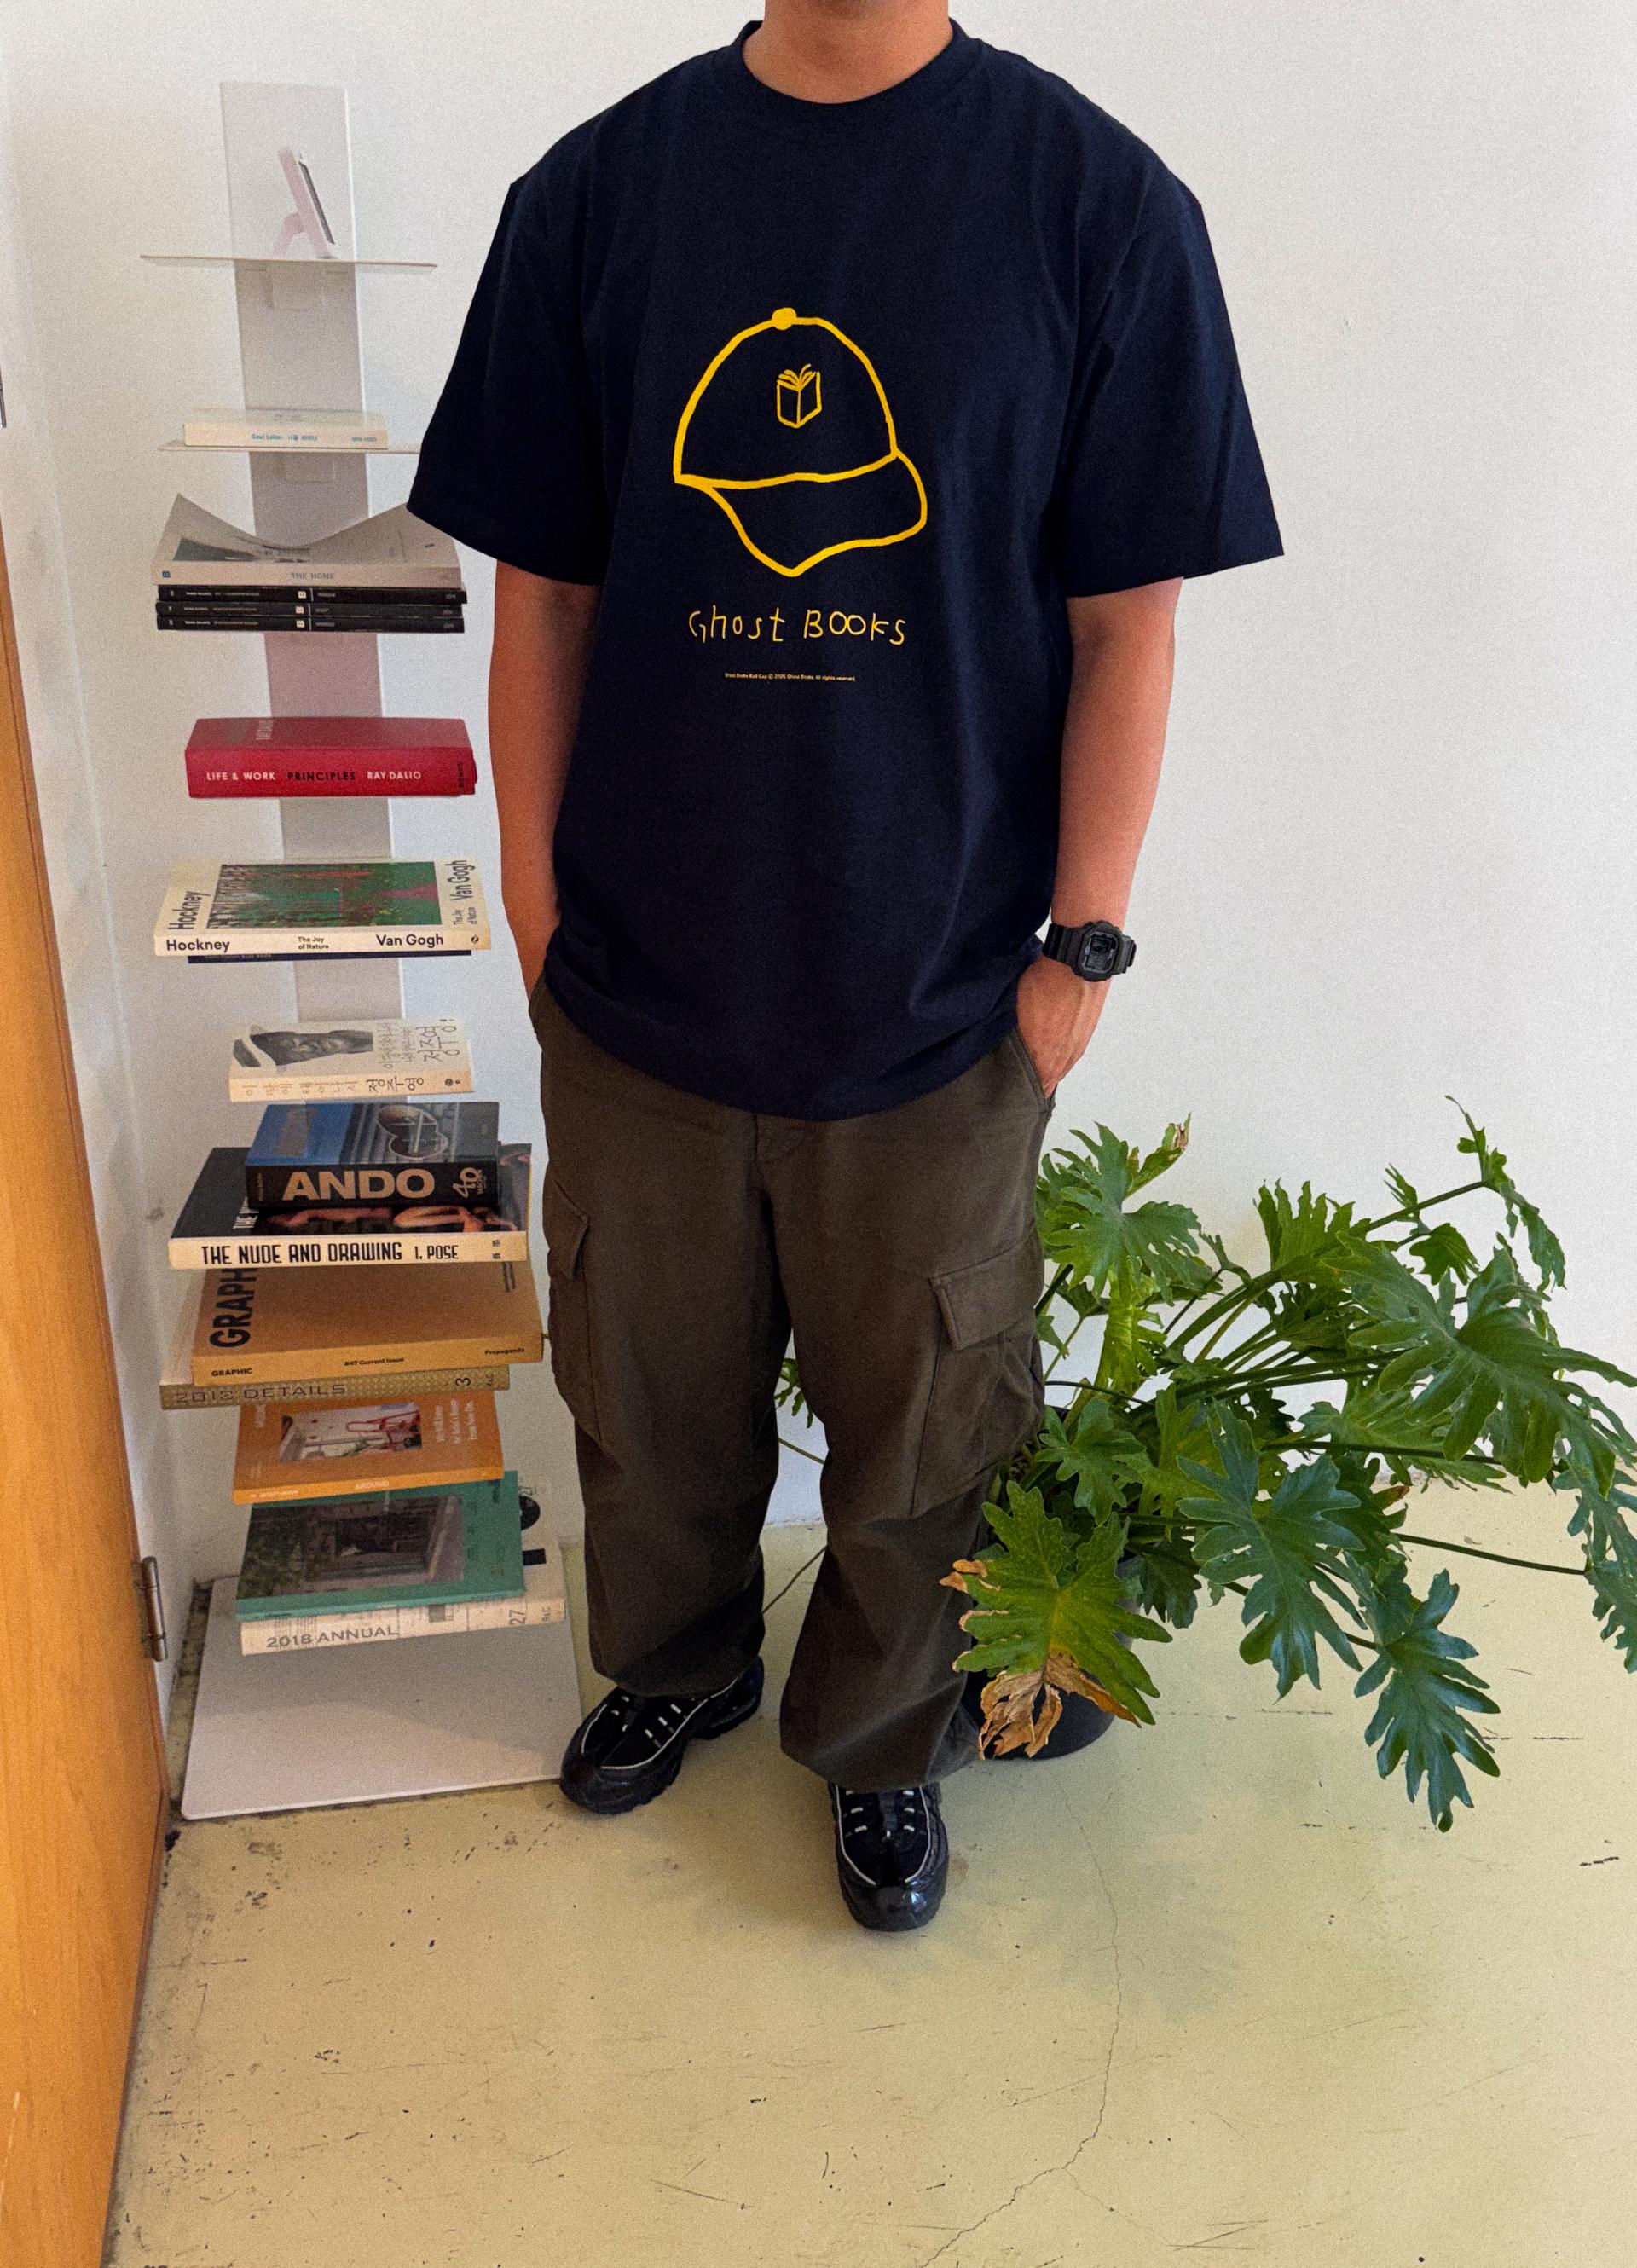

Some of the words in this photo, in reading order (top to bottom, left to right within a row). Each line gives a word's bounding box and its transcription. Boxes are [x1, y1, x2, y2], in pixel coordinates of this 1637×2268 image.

[689, 605, 785, 643] Ghost
[206, 771, 228, 781] LIFE
[232, 771, 239, 781] &
[243, 771, 276, 781] WORK
[286, 771, 356, 781] PRINCIPLES
[367, 771, 386, 780] RAY
[389, 771, 421, 780] DALIO
[443, 860, 476, 883] Gogh
[449, 884, 473, 901] Van
[167, 890, 211, 931] Hockney
[165, 938, 230, 953] Hockney
[312, 936, 324, 945] Joy
[377, 934, 402, 946] Van
[406, 933, 443, 948] Gogh
[367, 1076, 425, 1093] 정주영
[281, 1168, 435, 1201] ANDO
[201, 1245, 230, 1265] THE
[238, 1243, 281, 1264] NUDE
[289, 1243, 321, 1262] AND
[327, 1241, 402, 1262] DRAWING
[426, 1244, 459, 1260] POSE
[211, 1368, 253, 1377] GRAPHIC
[455, 1377, 471, 1386] 3
[244, 1383, 346, 1400] DETAILS
[508, 1609, 525, 1626] 27
[317, 1625, 400, 1644] ANNUAL
